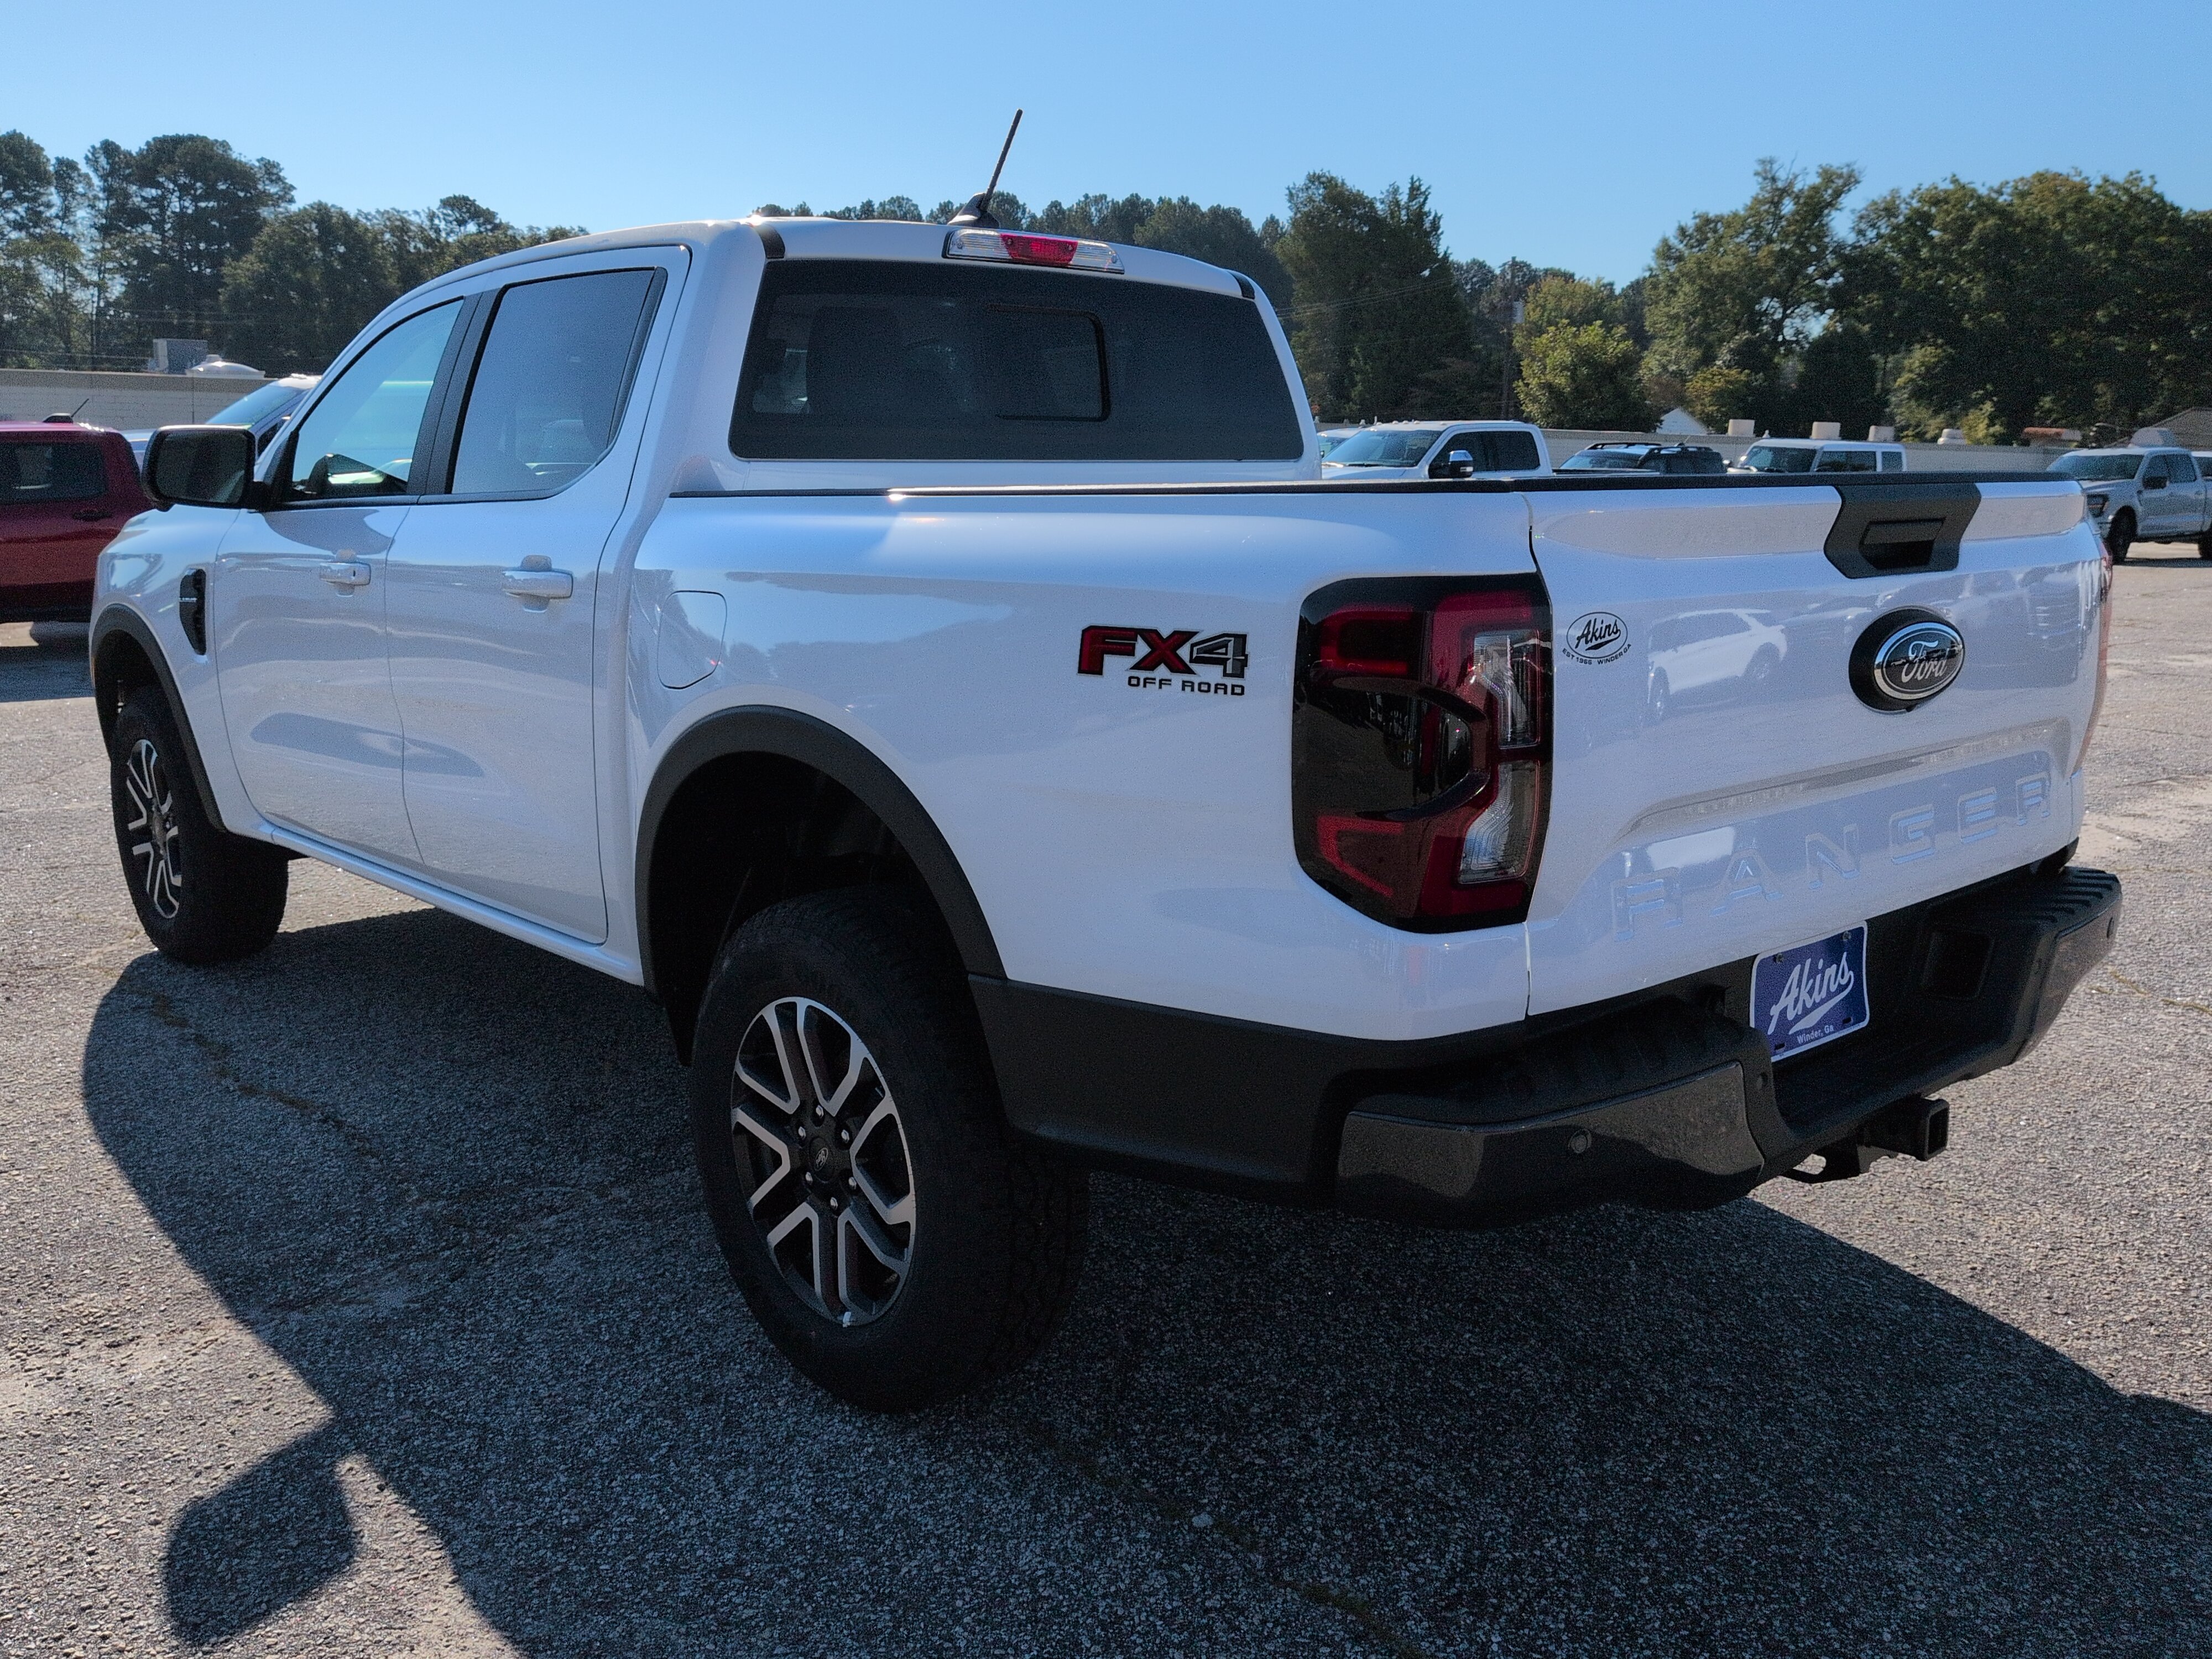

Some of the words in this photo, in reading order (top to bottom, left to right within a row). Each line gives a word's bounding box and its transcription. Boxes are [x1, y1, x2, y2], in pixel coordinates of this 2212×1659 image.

[1077, 625, 1248, 679] FX4
[1575, 618, 1621, 651] Akins
[1562, 648, 1575, 660] EST
[1597, 652, 1623, 665] WINDER
[1624, 644, 1632, 654] GA
[1901, 640, 1950, 683] Ford
[1128, 676, 1171, 689] OFF
[1182, 680, 1245, 696] ROAD
[1611, 773, 2051, 941] RANGER
[1767, 951, 1854, 1035] Akins
[1824, 1025, 1834, 1034] Ga
